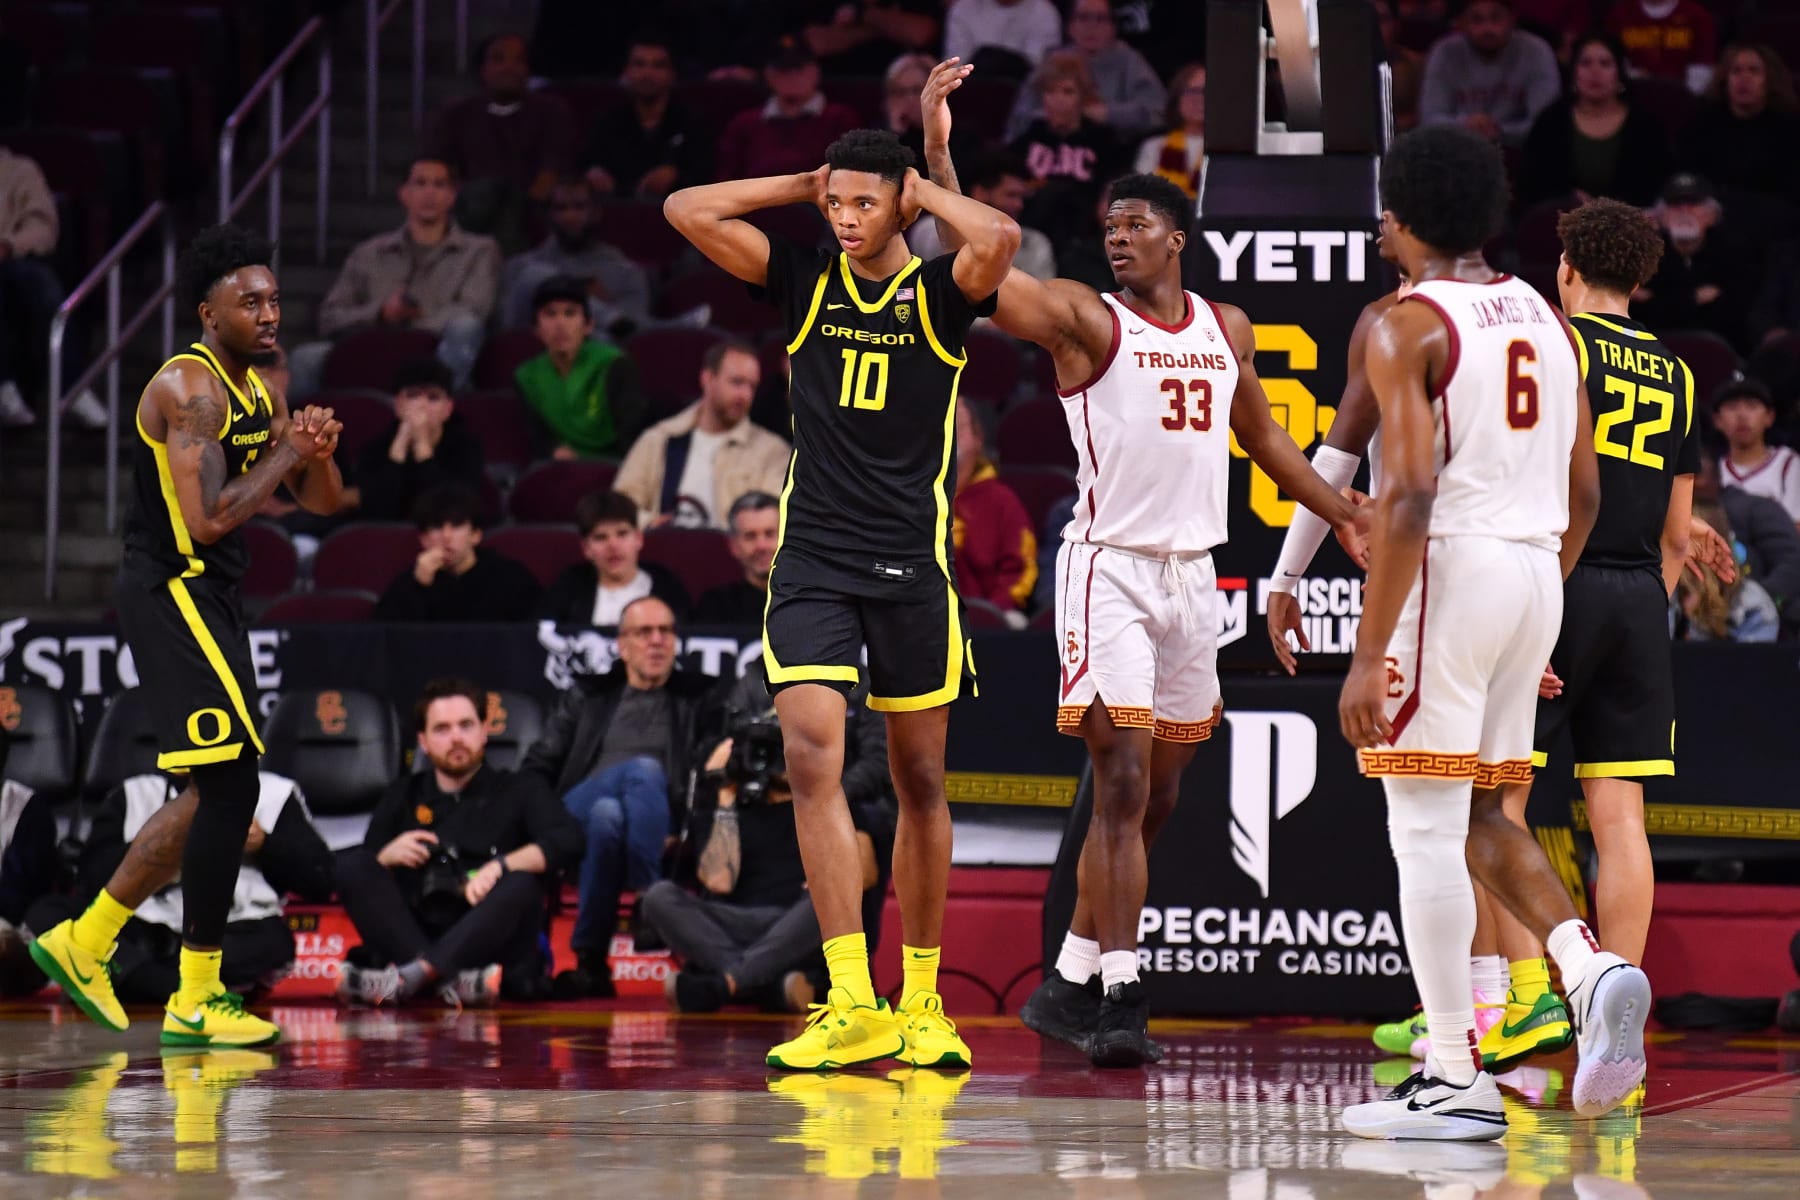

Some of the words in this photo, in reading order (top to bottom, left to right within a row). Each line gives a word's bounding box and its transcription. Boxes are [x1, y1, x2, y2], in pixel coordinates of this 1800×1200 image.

[1203, 230, 1366, 282] YETI
[1472, 297, 1524, 328] JAMES
[821, 324, 915, 345] OREGON
[839, 348, 889, 411] 10
[1133, 352, 1227, 370] TROJANS
[1595, 339, 1675, 384] TRACEY
[1159, 377, 1212, 433] 33
[1506, 338, 1539, 431] 6
[231, 430, 270, 446] OREGO
[1594, 374, 1675, 470] 22
[187, 708, 232, 747] O
[1137, 905, 1400, 948] PECHANGA
[1135, 947, 1261, 975] RESORT
[1278, 951, 1402, 977] CASINO
